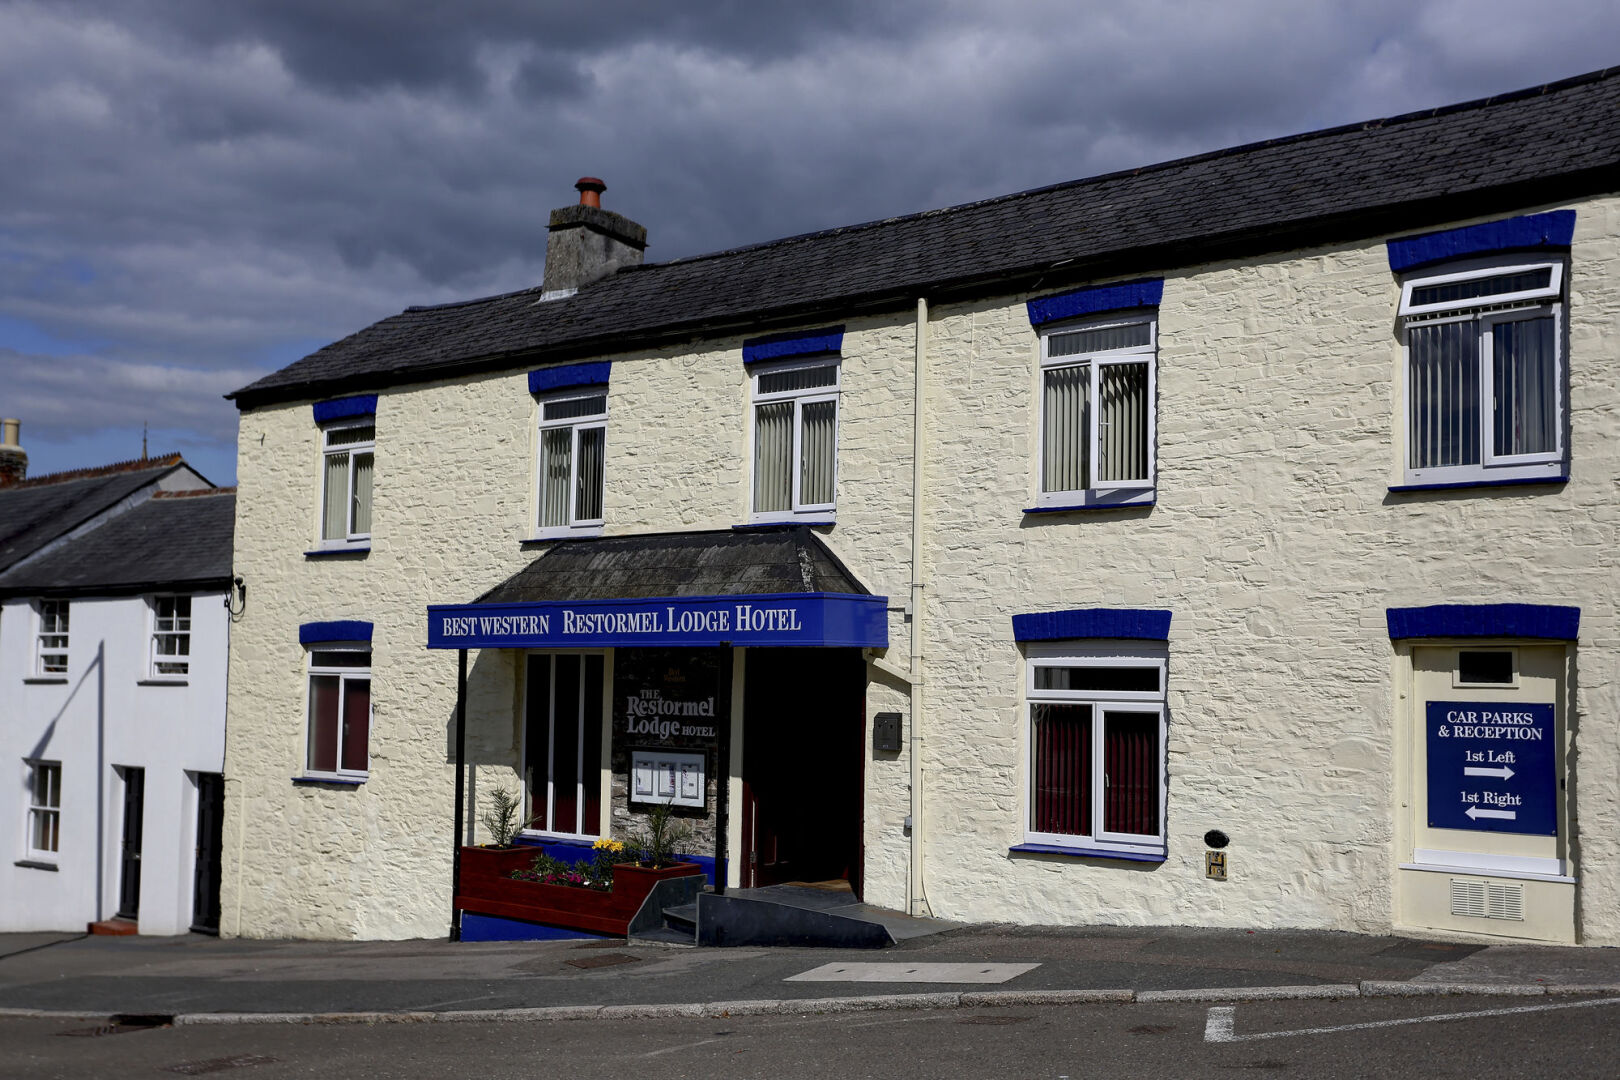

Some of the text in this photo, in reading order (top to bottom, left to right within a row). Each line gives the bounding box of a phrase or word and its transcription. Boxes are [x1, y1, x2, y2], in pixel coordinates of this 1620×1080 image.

[442, 605, 801, 636] BEST WESTERN RESTORMEL LODGE HOTEL
[640, 690, 660, 700] THE
[626, 696, 714, 717] Restormel
[1447, 710, 1533, 726] CAR PARKS
[626, 716, 716, 740] Lodge HOTEL
[1438, 725, 1543, 740] & RECEPTION
[1466, 750, 1516, 764] 1st Left
[1460, 791, 1522, 807] 1st Right
